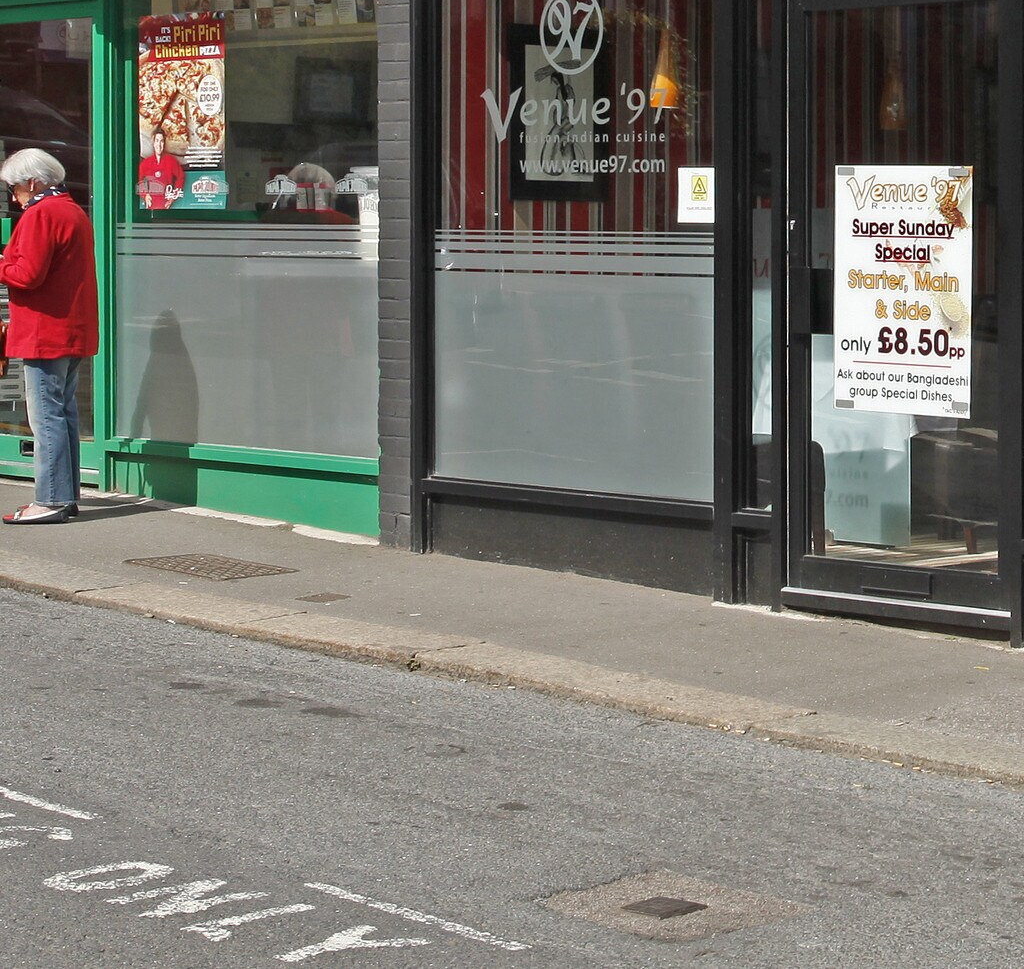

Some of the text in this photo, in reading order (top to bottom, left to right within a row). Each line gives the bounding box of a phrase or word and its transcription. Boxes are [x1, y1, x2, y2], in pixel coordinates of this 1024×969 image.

[173, 23, 220, 43] Piri Piri
[155, 44, 221, 58] Chicken PIZZA
[480, 86, 611, 143] Venue
[519, 131, 666, 143] fusion indian cuisine
[519, 155, 666, 174] www.venue97.com
[846, 175, 928, 211] Venue
[852, 218, 954, 240] Super Sunday
[875, 243, 930, 263] Special
[848, 268, 959, 293] Starter, Main
[875, 299, 931, 321] & Side
[840, 336, 872, 356] only
[837, 368, 969, 388] Ask about our Bangladeshi
[849, 387, 878, 400] group
[881, 387, 918, 401] Special
